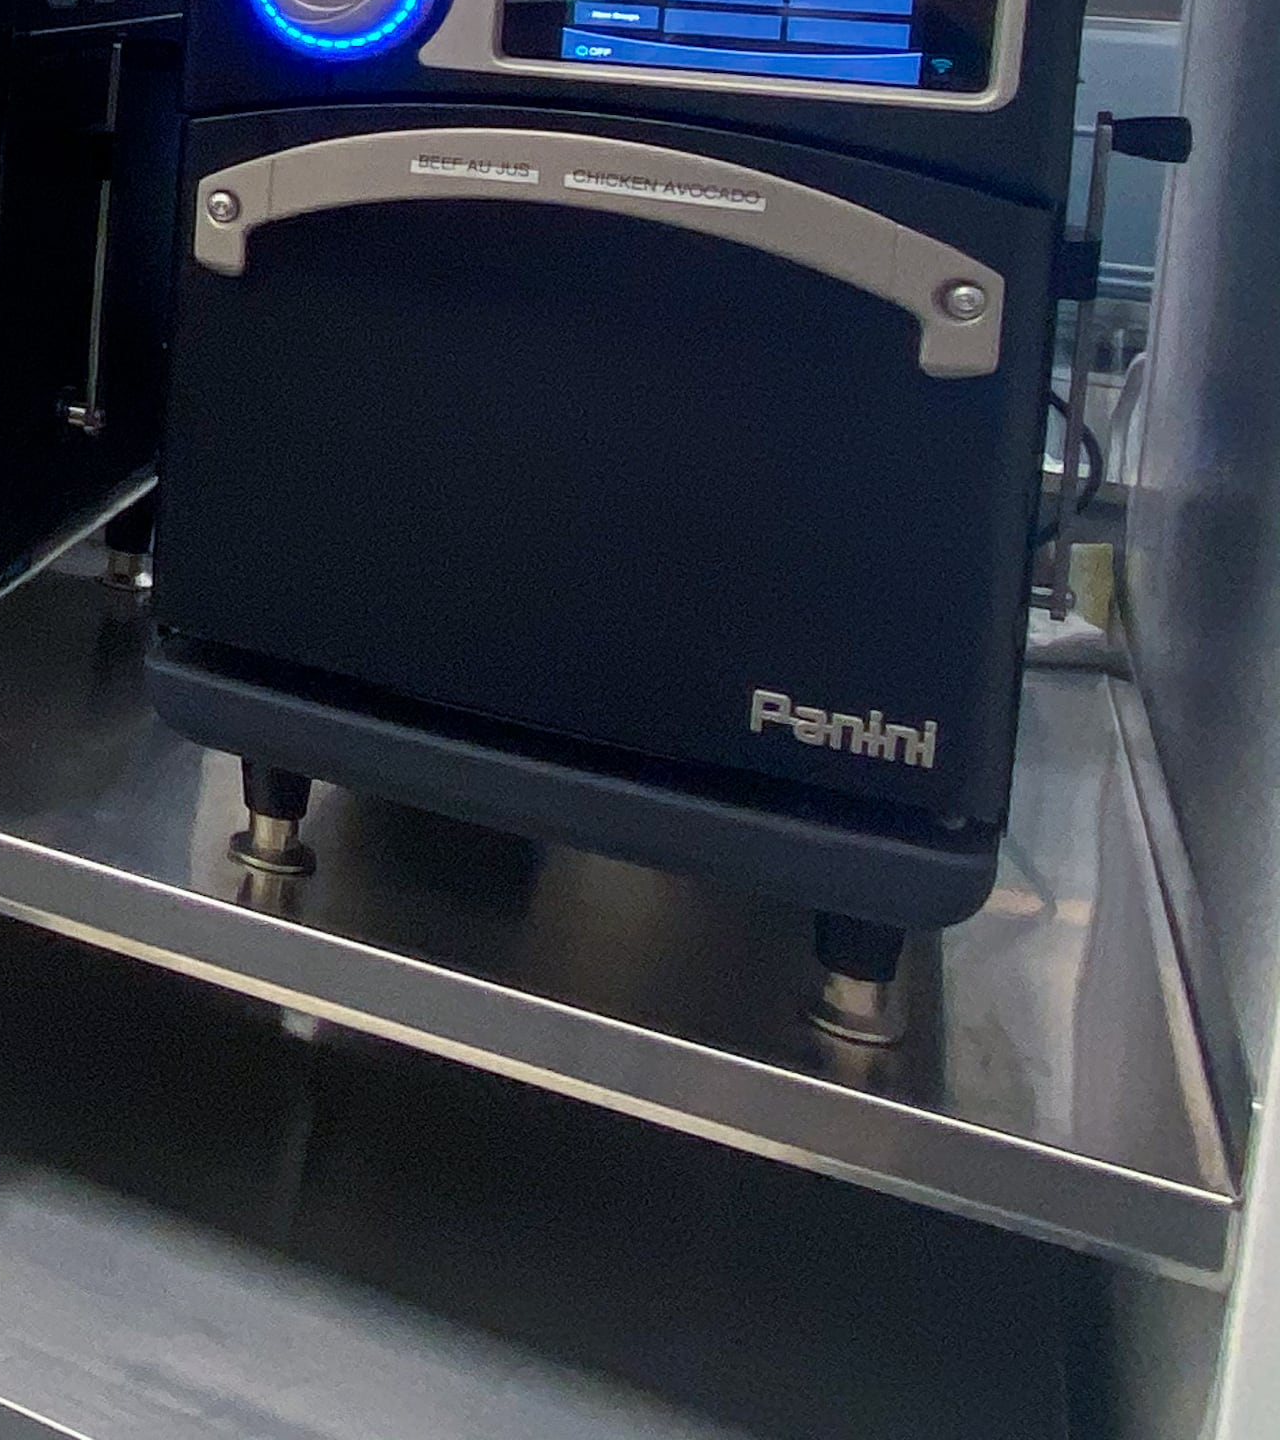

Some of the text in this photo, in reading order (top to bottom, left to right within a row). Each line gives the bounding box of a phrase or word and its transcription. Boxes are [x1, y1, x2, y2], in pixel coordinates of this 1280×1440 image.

[418, 154, 531, 177] BEEF AU JUS
[572, 168, 761, 205] CHICKEN AVOCADO
[750, 688, 938, 769] Panini
